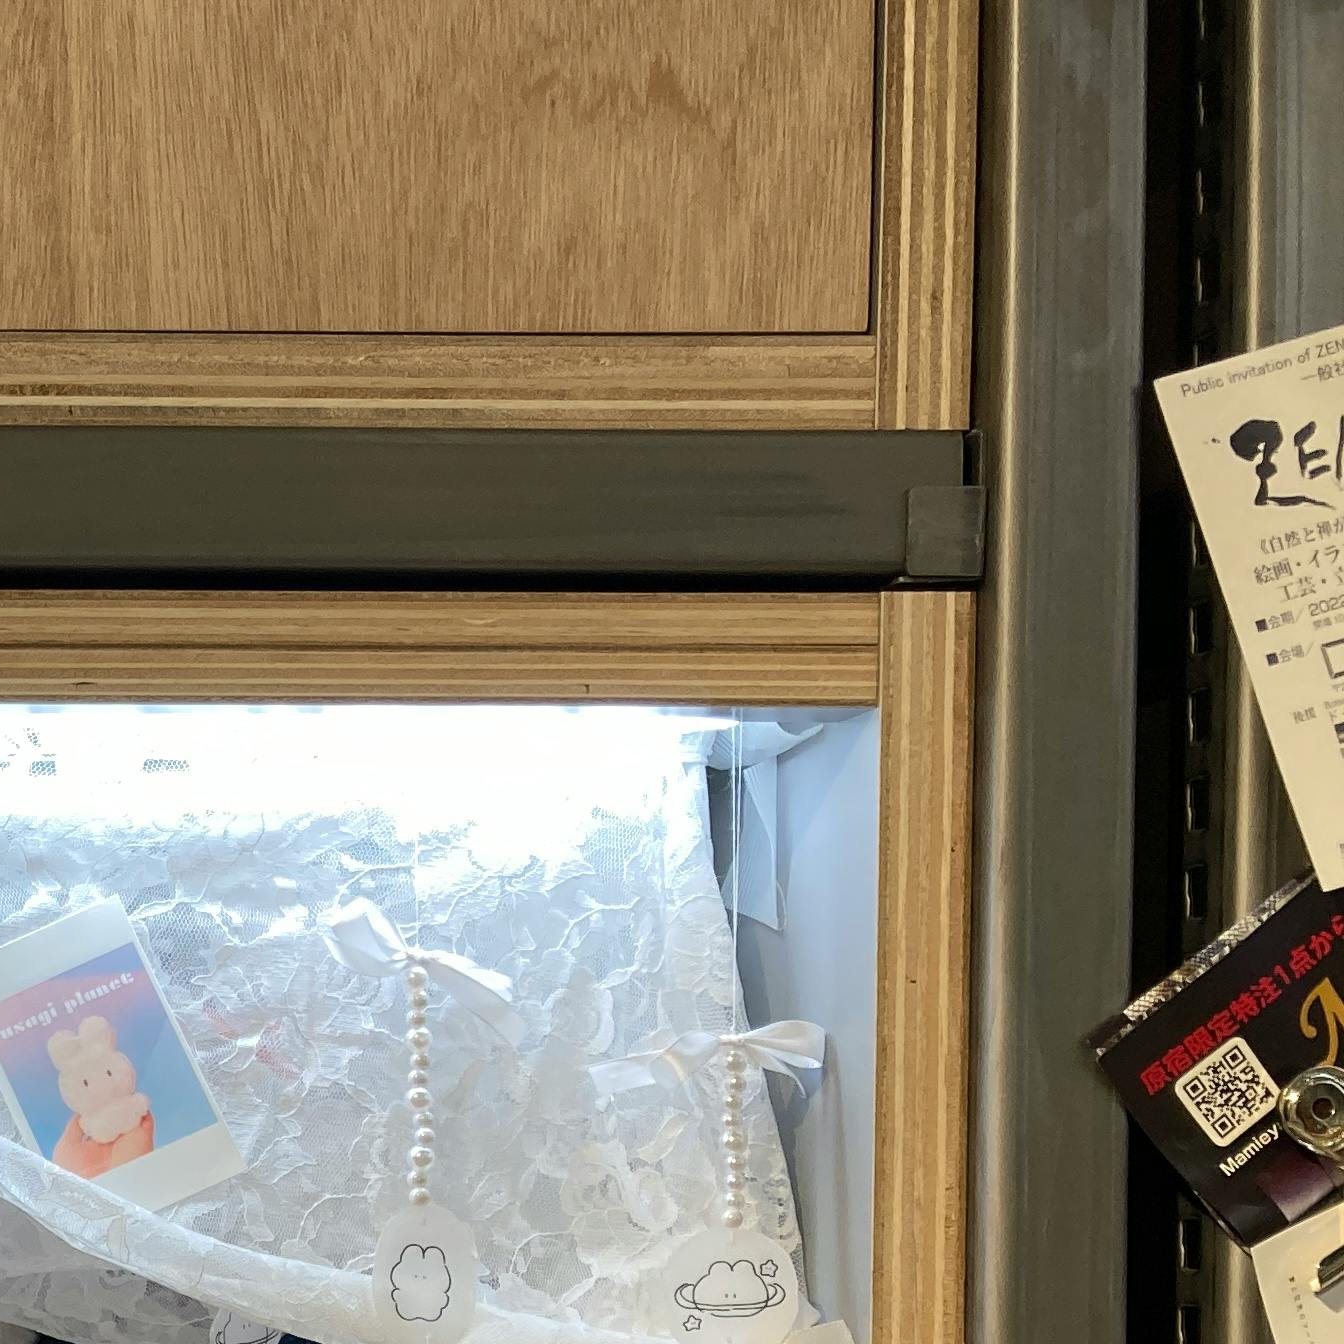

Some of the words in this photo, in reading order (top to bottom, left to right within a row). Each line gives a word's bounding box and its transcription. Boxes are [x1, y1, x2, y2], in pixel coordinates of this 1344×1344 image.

[1180, 377, 1225, 398] Public
[1228, 358, 1293, 384] invitation
[1296, 349, 1312, 365] of
[1218, 1120, 1284, 1178] Mamiey
